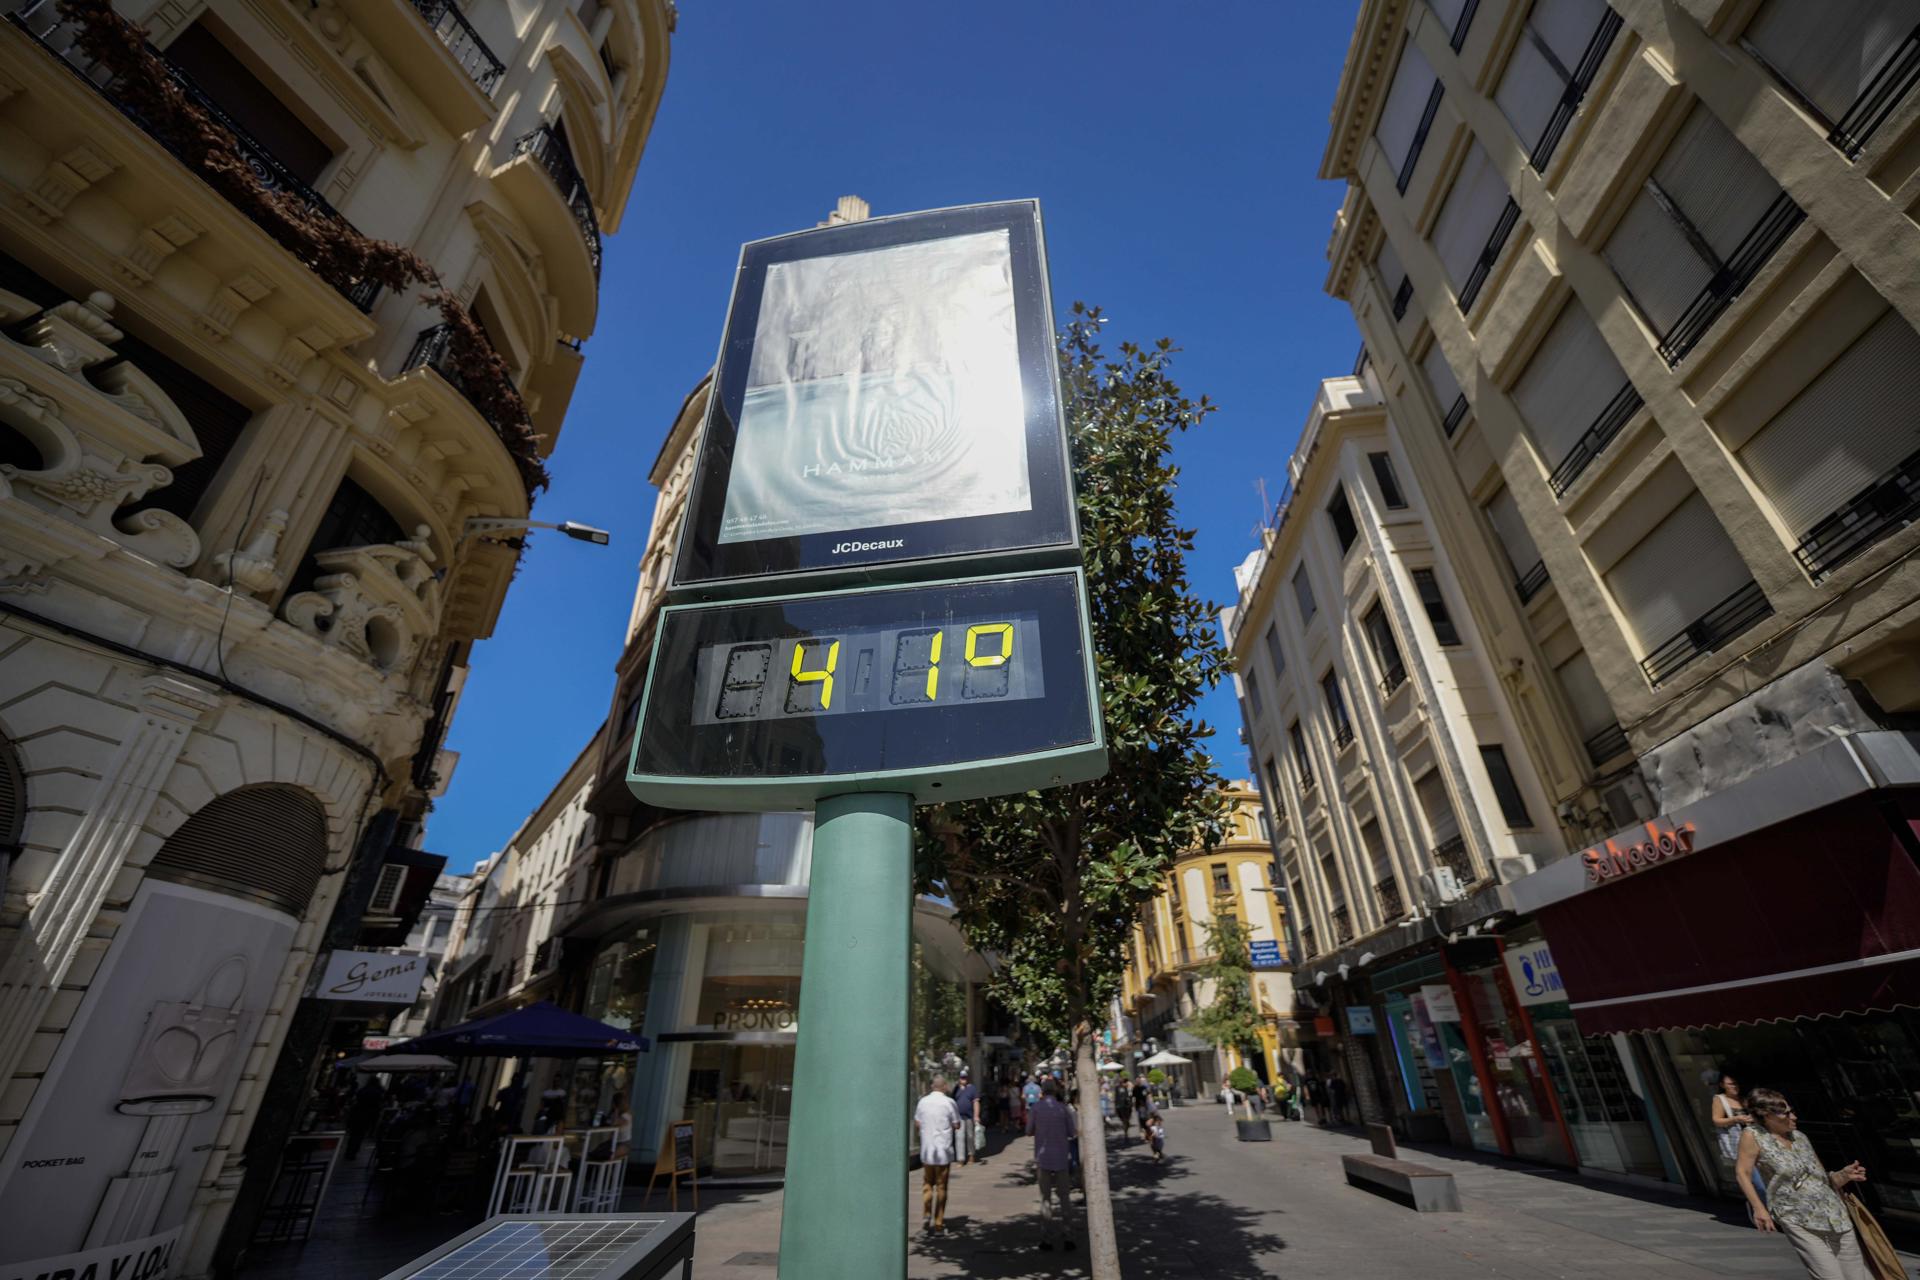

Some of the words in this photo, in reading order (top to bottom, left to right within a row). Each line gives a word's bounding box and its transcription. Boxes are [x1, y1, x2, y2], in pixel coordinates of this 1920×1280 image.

[802, 450, 942, 478] HAMMAM
[832, 539, 904, 554] JCDecaux
[1582, 820, 1696, 883] Salvador
[329, 960, 416, 994] Gema
[713, 1010, 799, 1030] PRONO
[22, 1158, 65, 1169] POCKET
[66, 1156, 86, 1166] BAG
